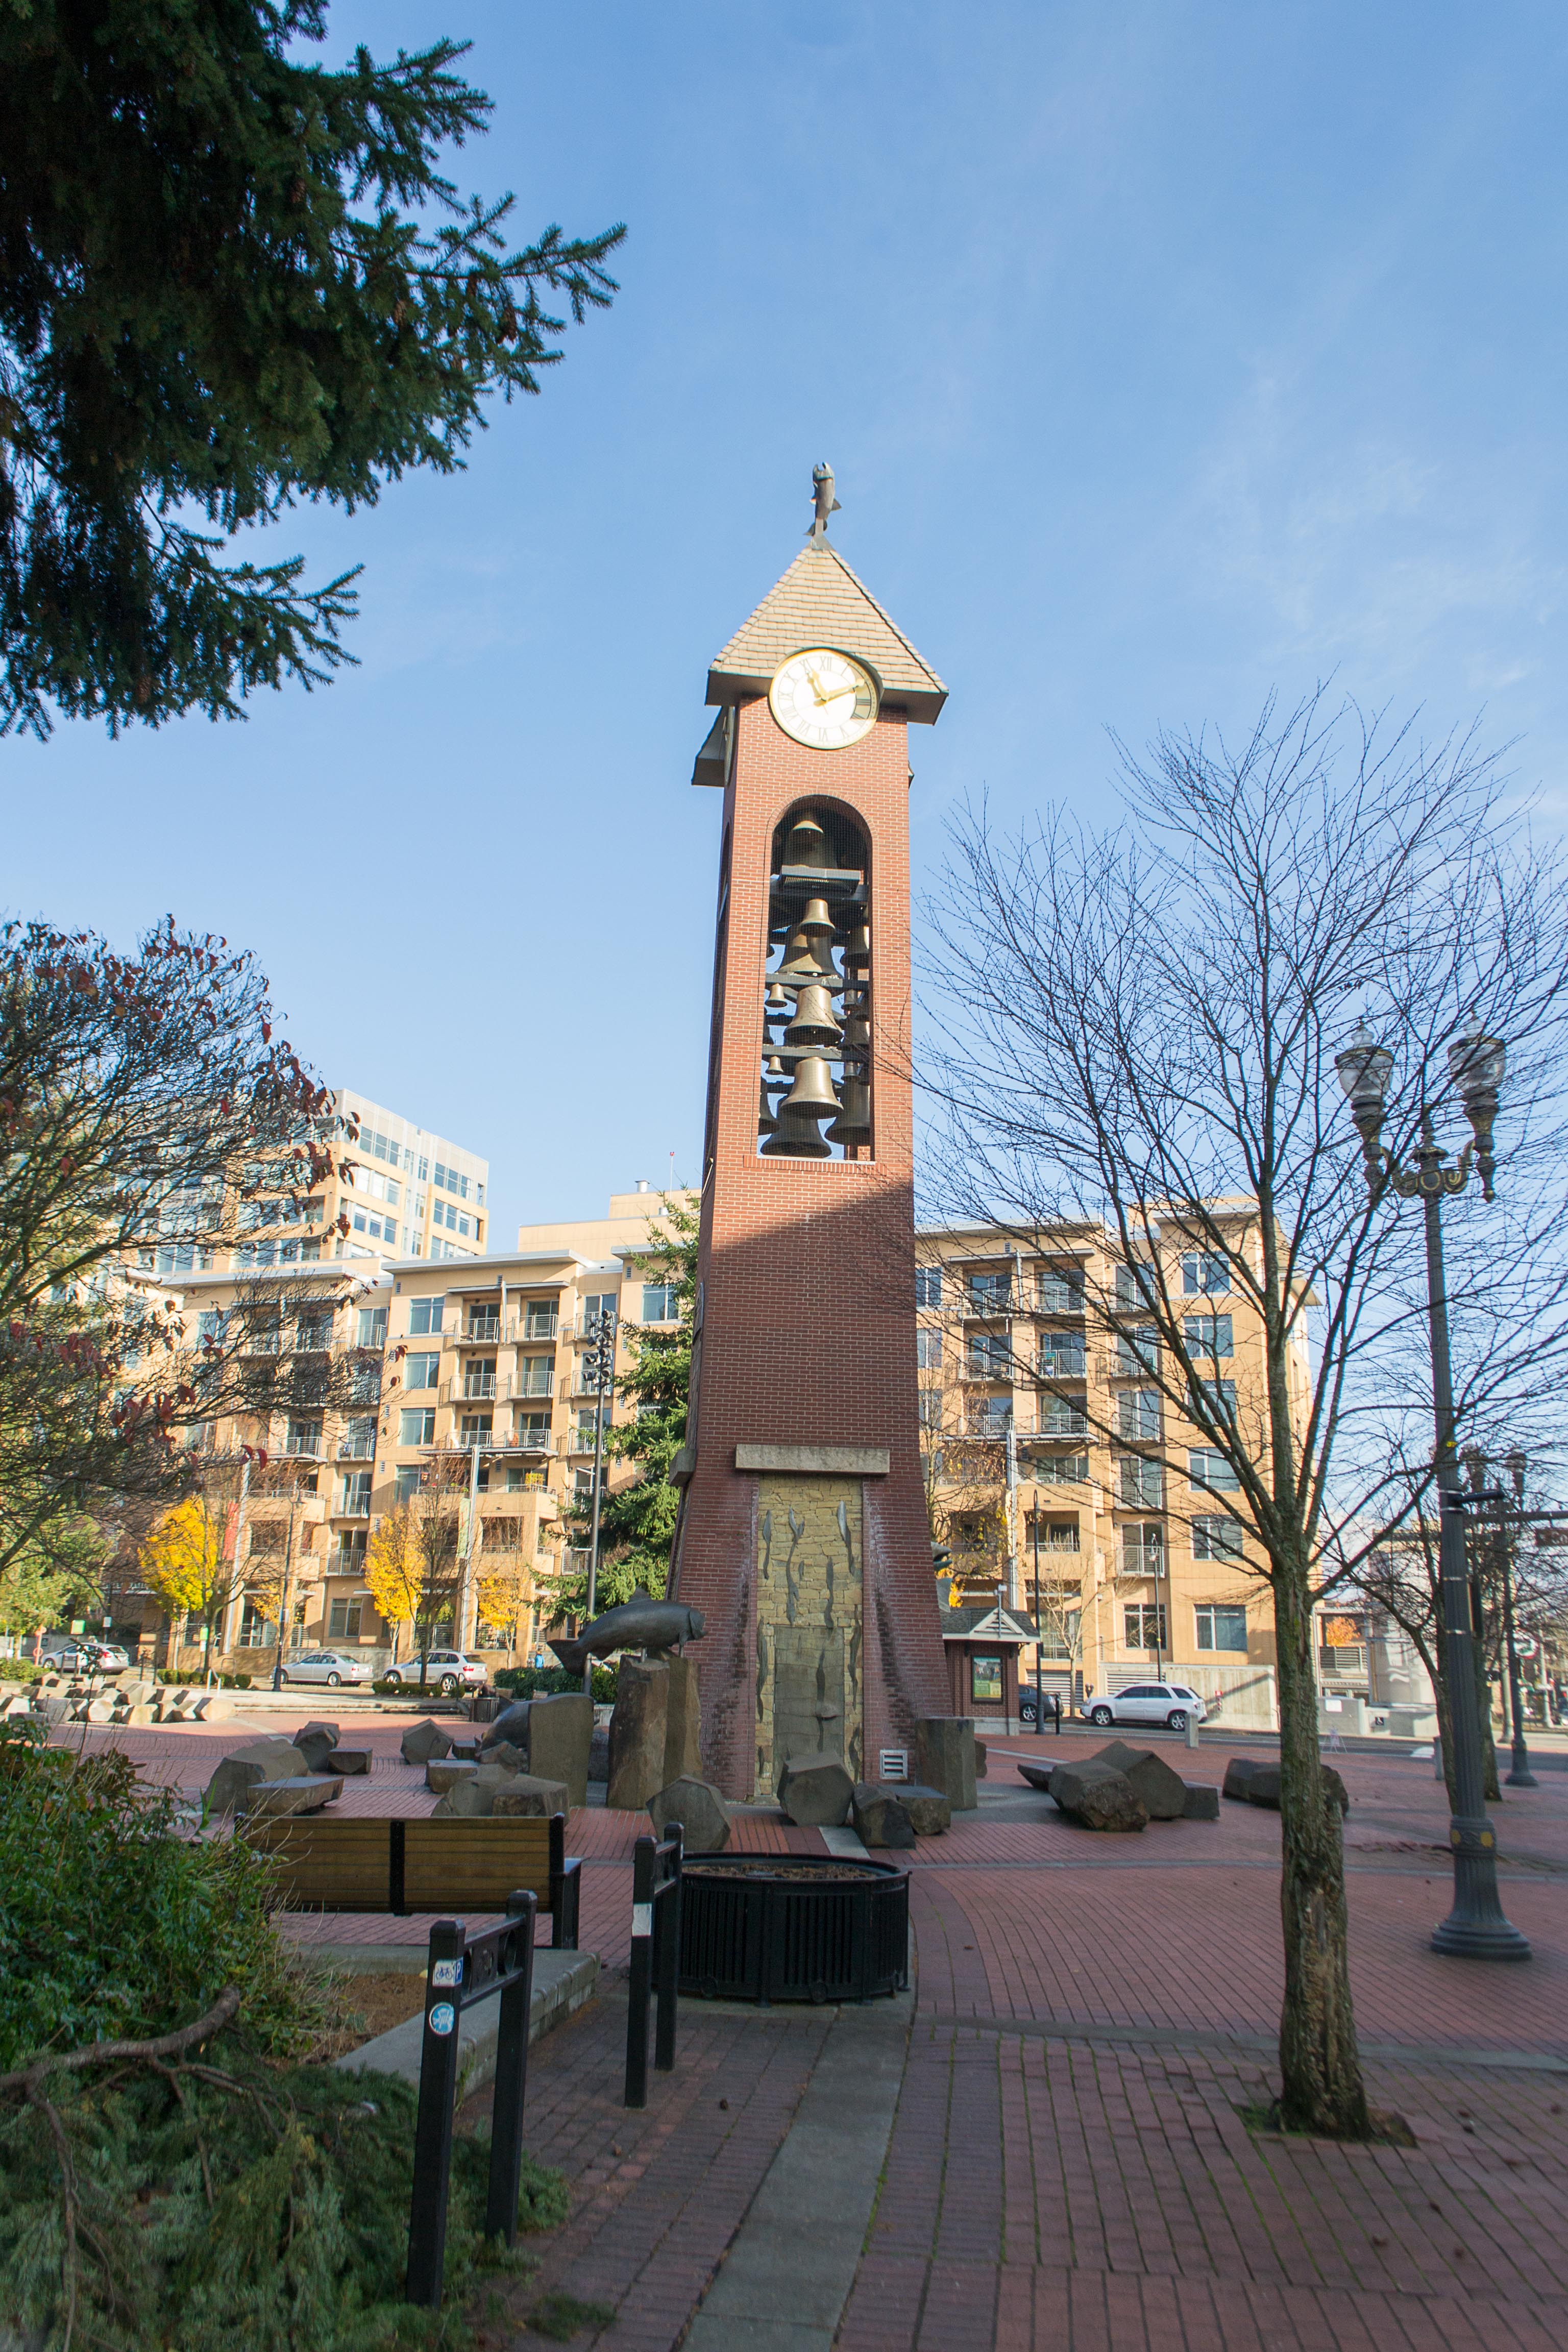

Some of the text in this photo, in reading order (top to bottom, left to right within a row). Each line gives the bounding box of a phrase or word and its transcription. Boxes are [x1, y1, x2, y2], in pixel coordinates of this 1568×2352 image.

[820, 657, 832, 671] XII
[783, 671, 799, 684] X
[456, 1962, 461, 1979] P
